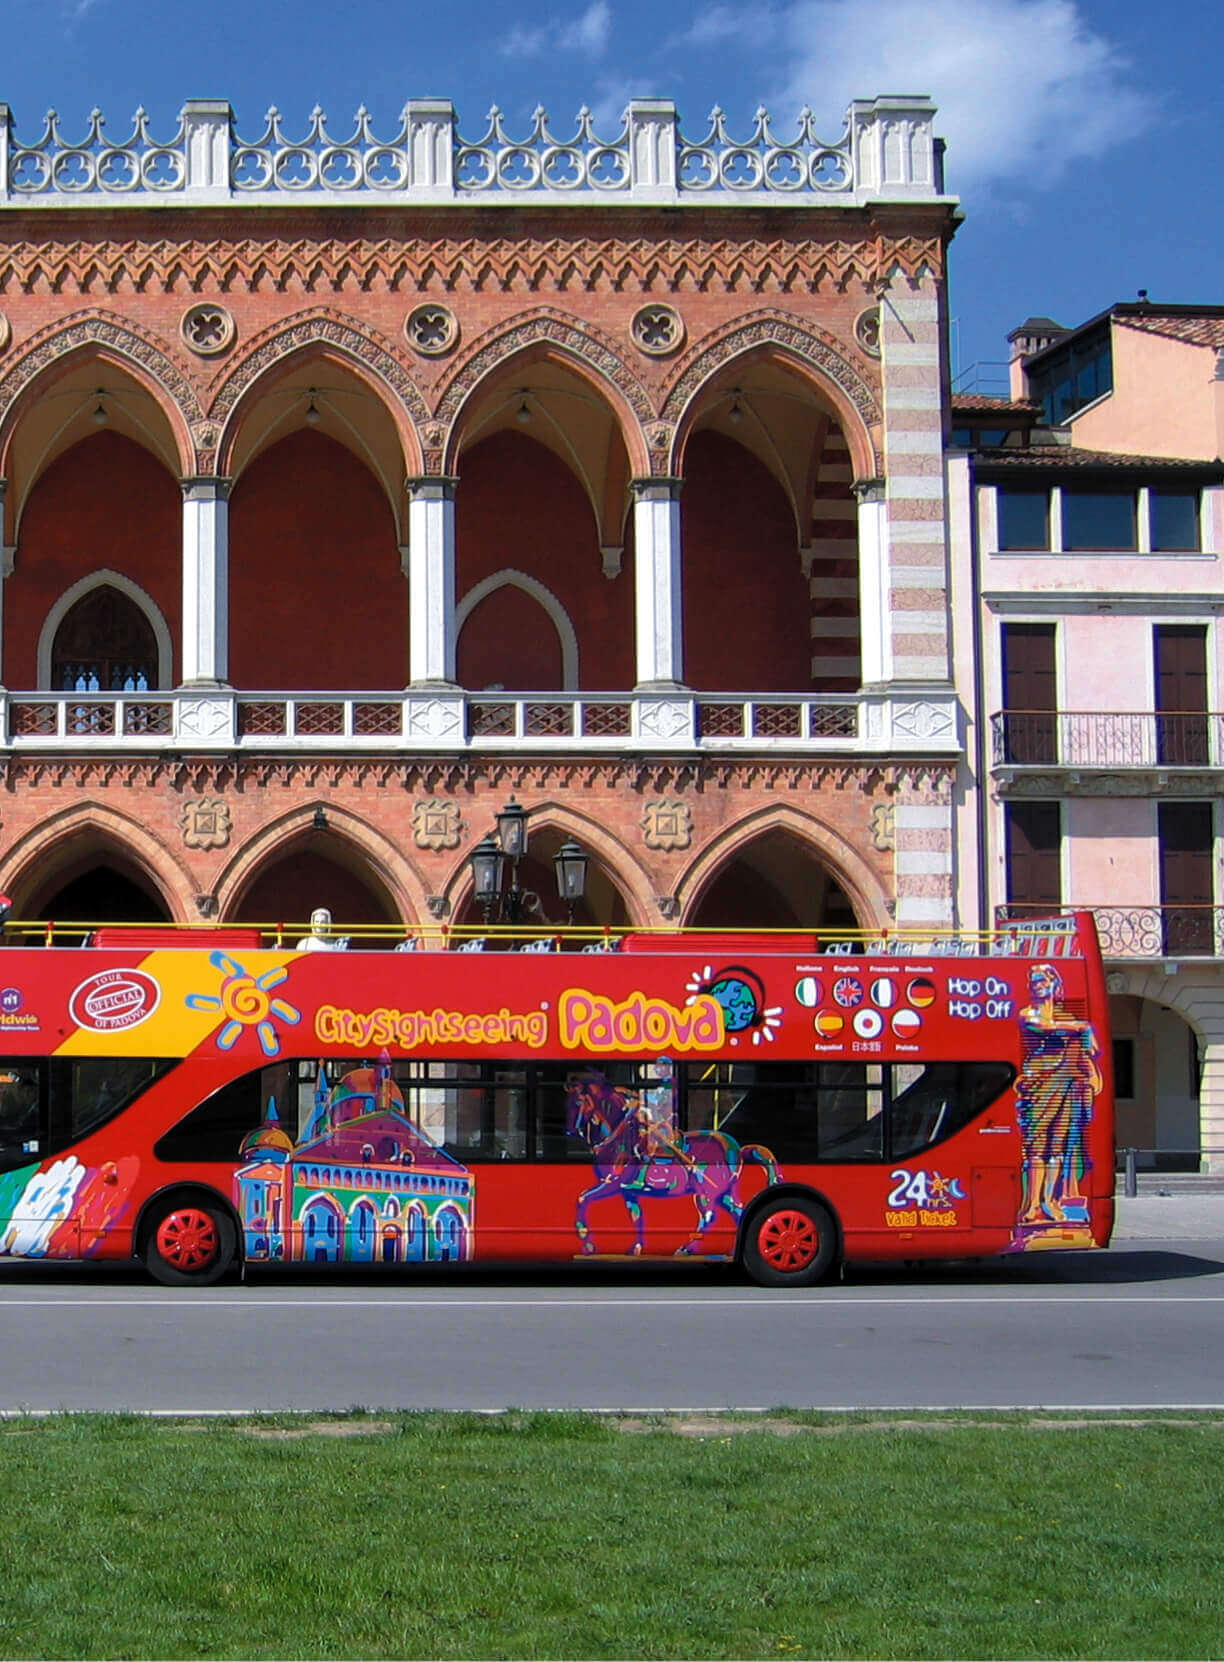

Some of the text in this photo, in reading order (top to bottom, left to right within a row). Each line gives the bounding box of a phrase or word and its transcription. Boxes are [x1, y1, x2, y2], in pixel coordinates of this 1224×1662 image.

[94, 973, 123, 986] TOUR
[948, 977, 1008, 997] Hop On
[89, 989, 142, 1012] OFFICIAL
[948, 999, 1012, 1020] Hop Off
[95, 1008, 147, 1028] OF PADOVA
[559, 988, 725, 1052] Padova
[888, 1169, 927, 1207] 24
[886, 1209, 957, 1227] Valid Ticket
